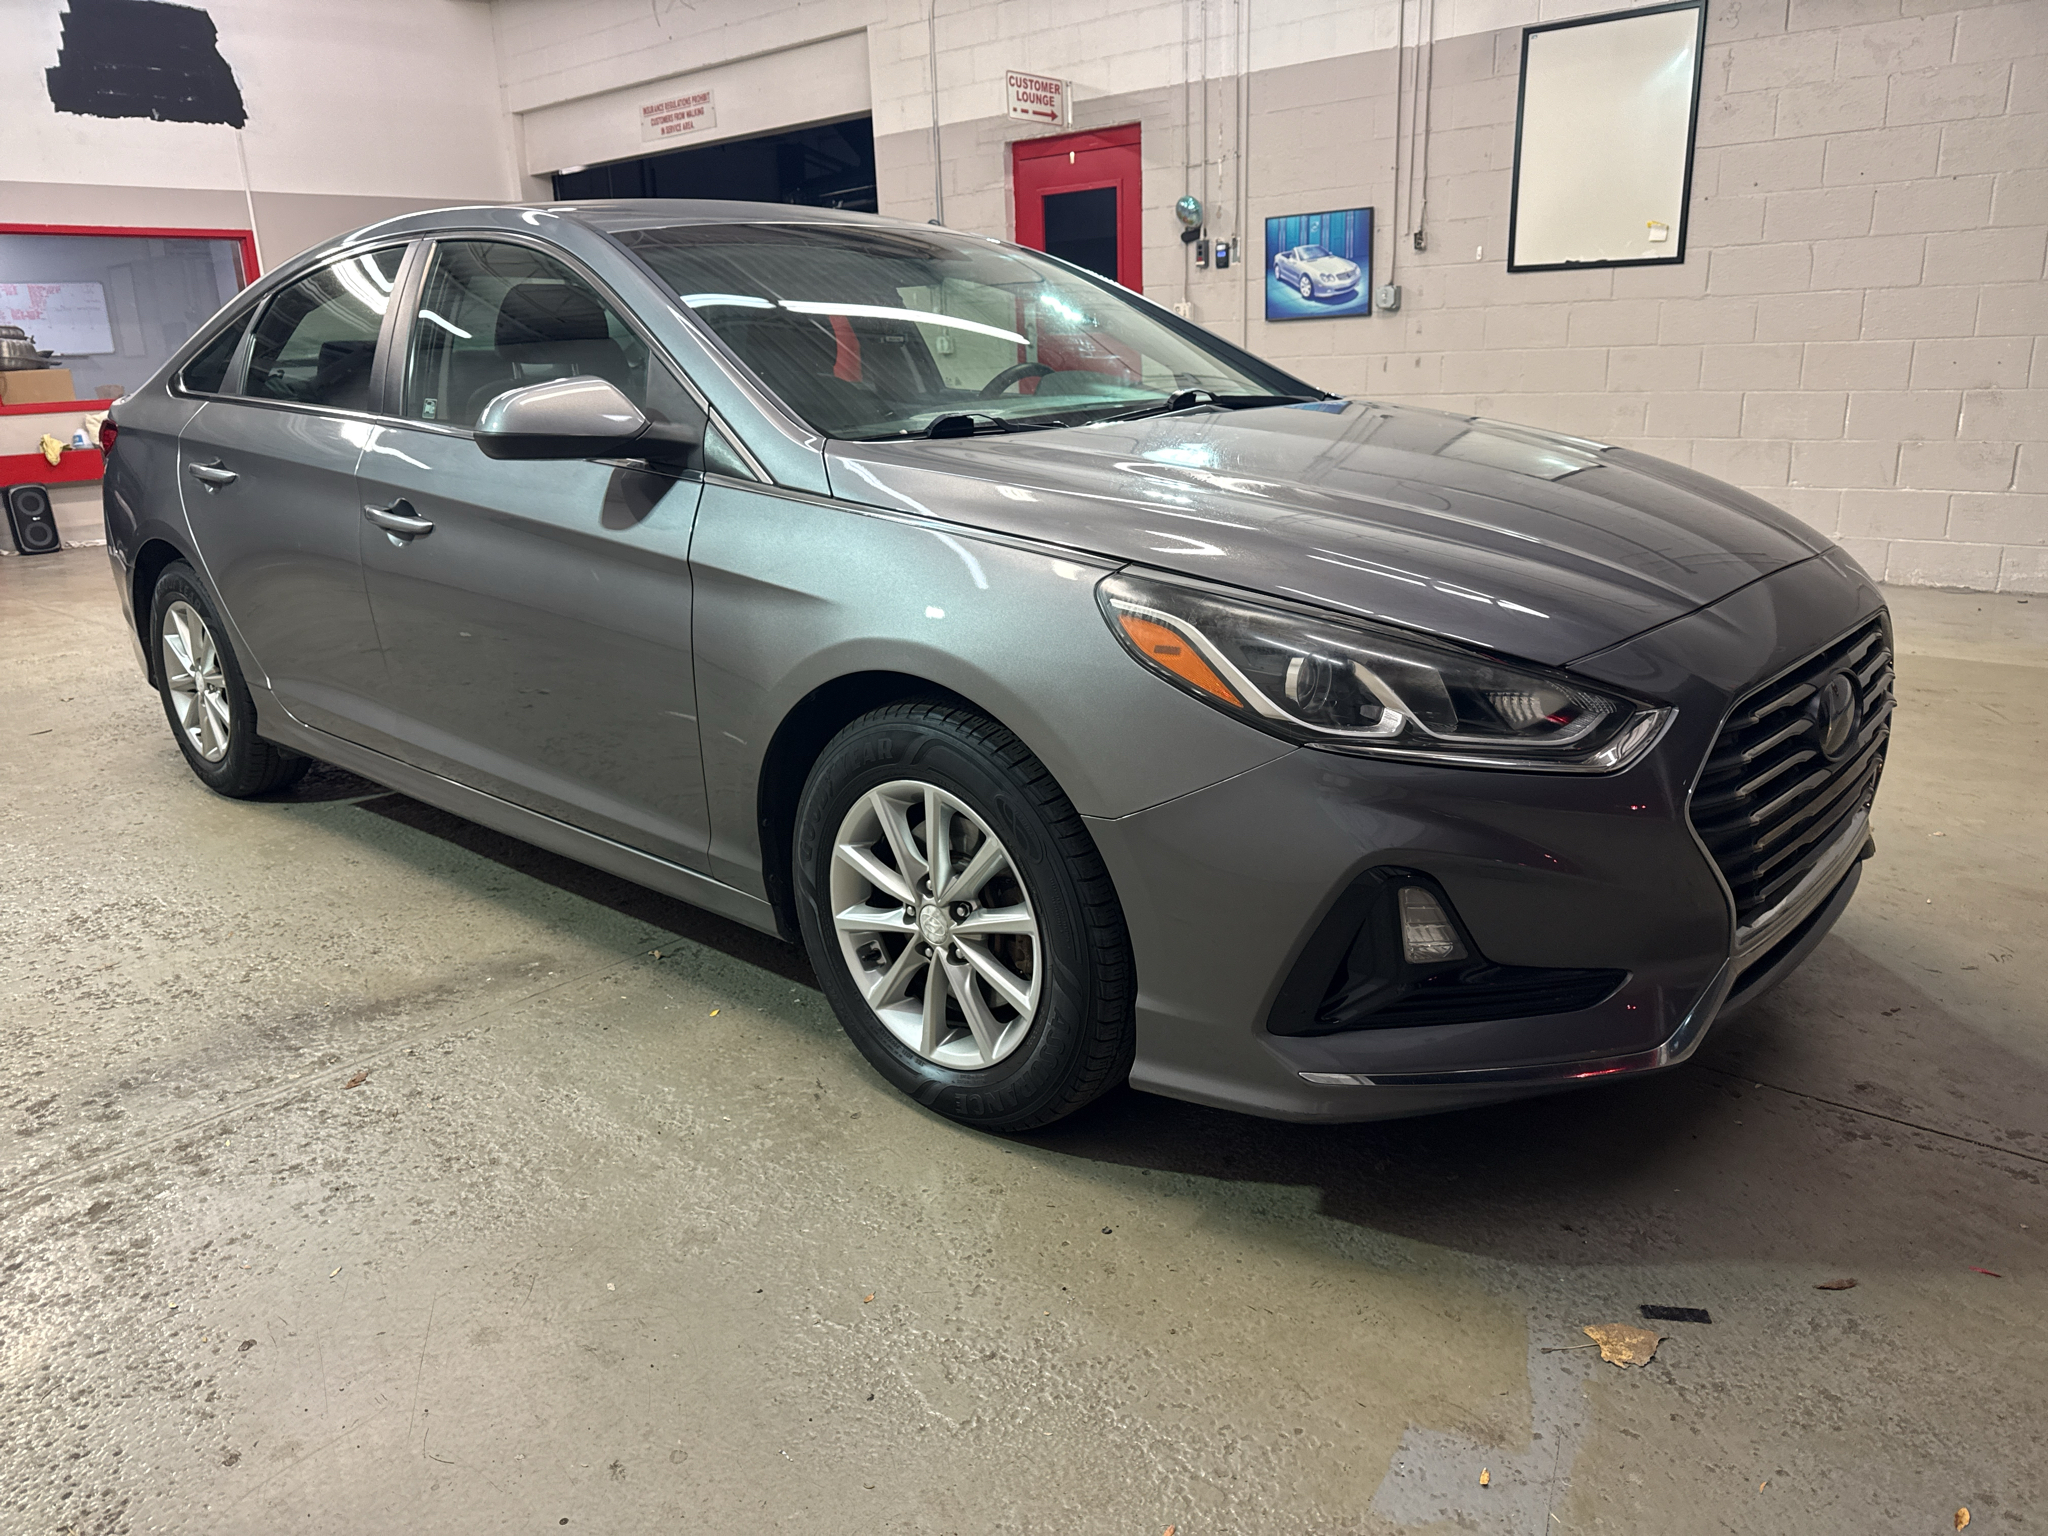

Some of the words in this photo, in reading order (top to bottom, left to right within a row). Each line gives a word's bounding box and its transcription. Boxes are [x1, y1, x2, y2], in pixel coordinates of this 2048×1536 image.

[1008, 75, 1061, 95] CUSTOMER
[643, 103, 664, 114] INSURANCE
[665, 97, 691, 110] REGULATIONS
[692, 92, 709, 102] PROHIBIT
[1016, 90, 1055, 107] LOUNGE
[651, 114, 673, 126] CUSTOMERS
[674, 111, 685, 120] FROM
[686, 107, 704, 117] WALKING
[666, 123, 681, 134] SERVICE
[954, 1006, 1070, 1115] ASSURANCE
